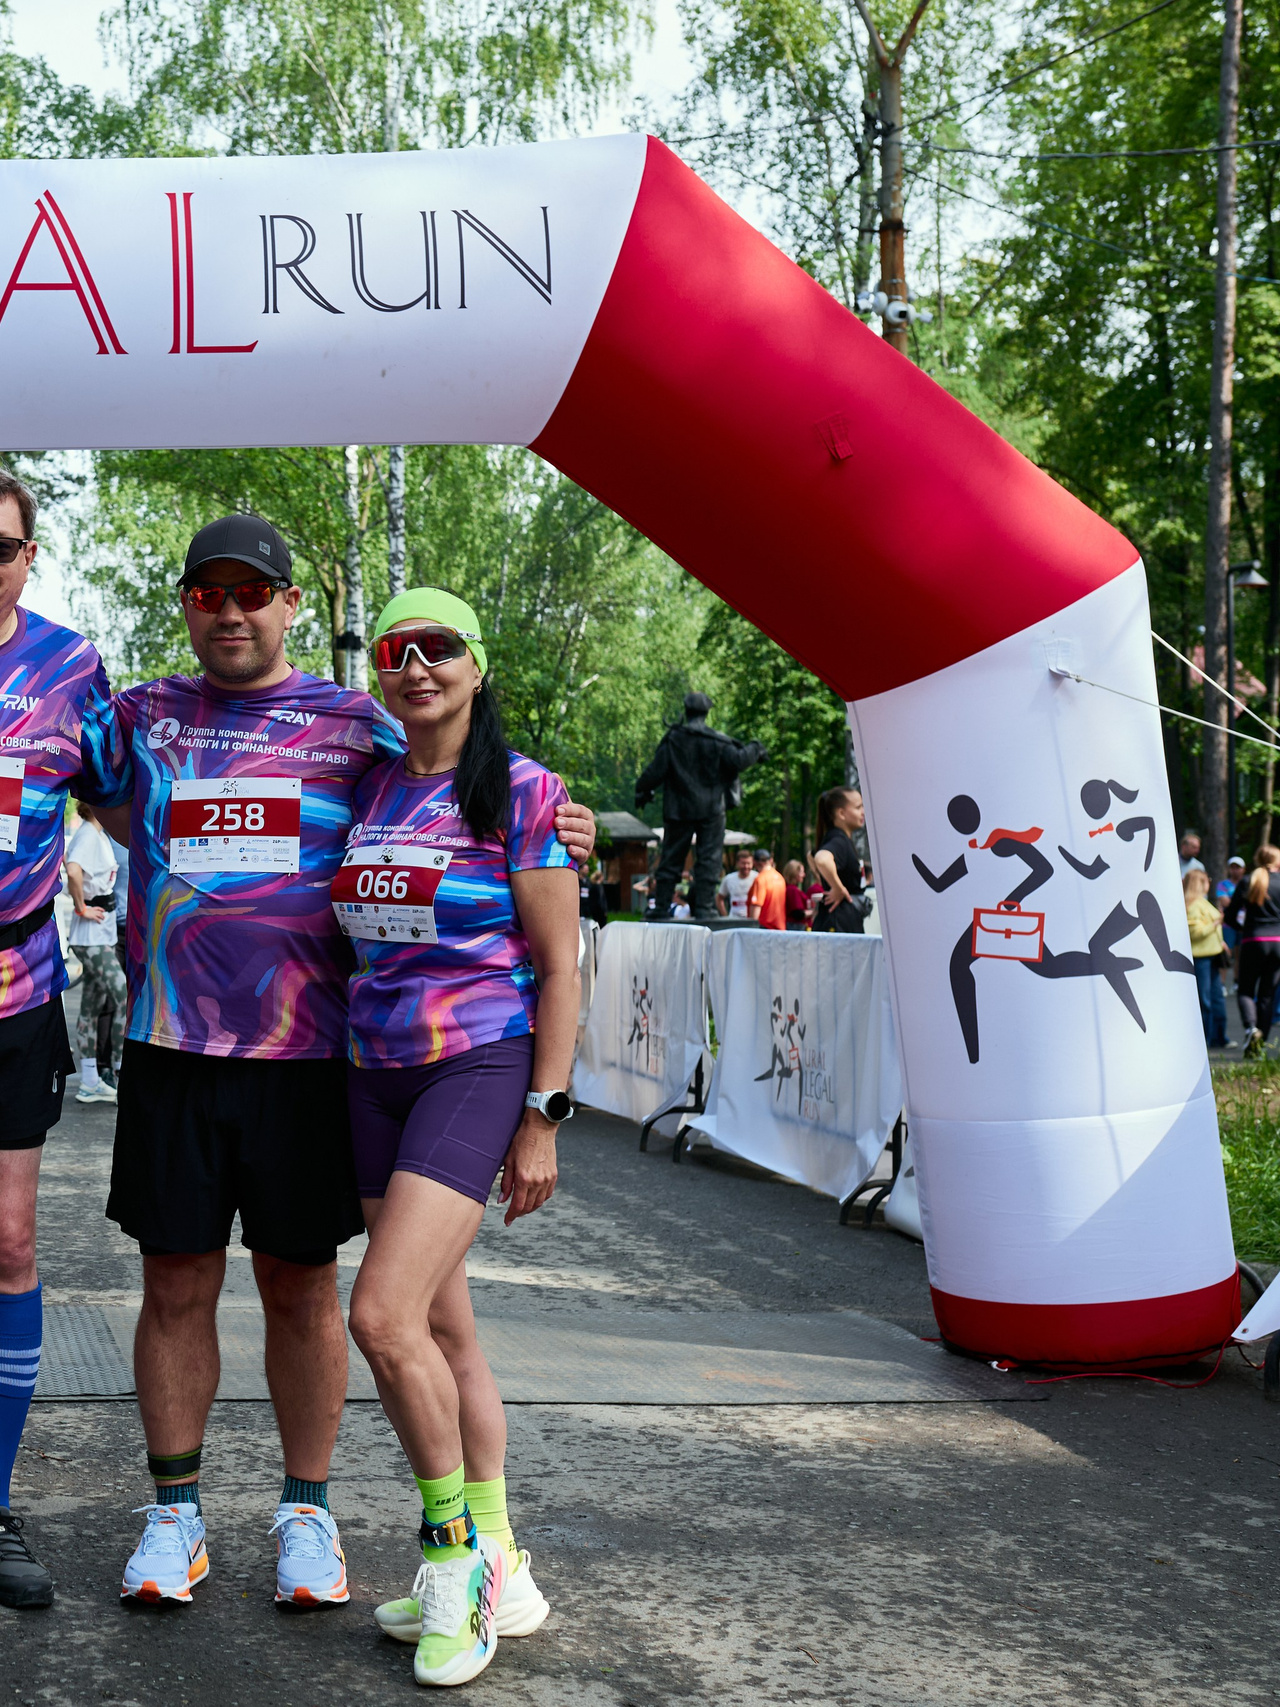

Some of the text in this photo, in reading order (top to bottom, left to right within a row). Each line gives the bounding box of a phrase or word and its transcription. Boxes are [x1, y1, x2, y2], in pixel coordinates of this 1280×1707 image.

[259, 205, 553, 314] RUN
[181, 725, 269, 742] Группа компаний
[33, 740, 61, 756] ПРАВО
[178, 737, 349, 765] НАЛОГИ И ФИНАНСОВОЕ ПРАВО
[201, 803, 265, 831] 258
[425, 801, 463, 819] RA
[389, 833, 438, 842] ФИНАНСОВОЕ
[439, 835, 470, 848] ПРАВО
[356, 869, 411, 899] 066
[804, 1070, 835, 1104] LEGAL
